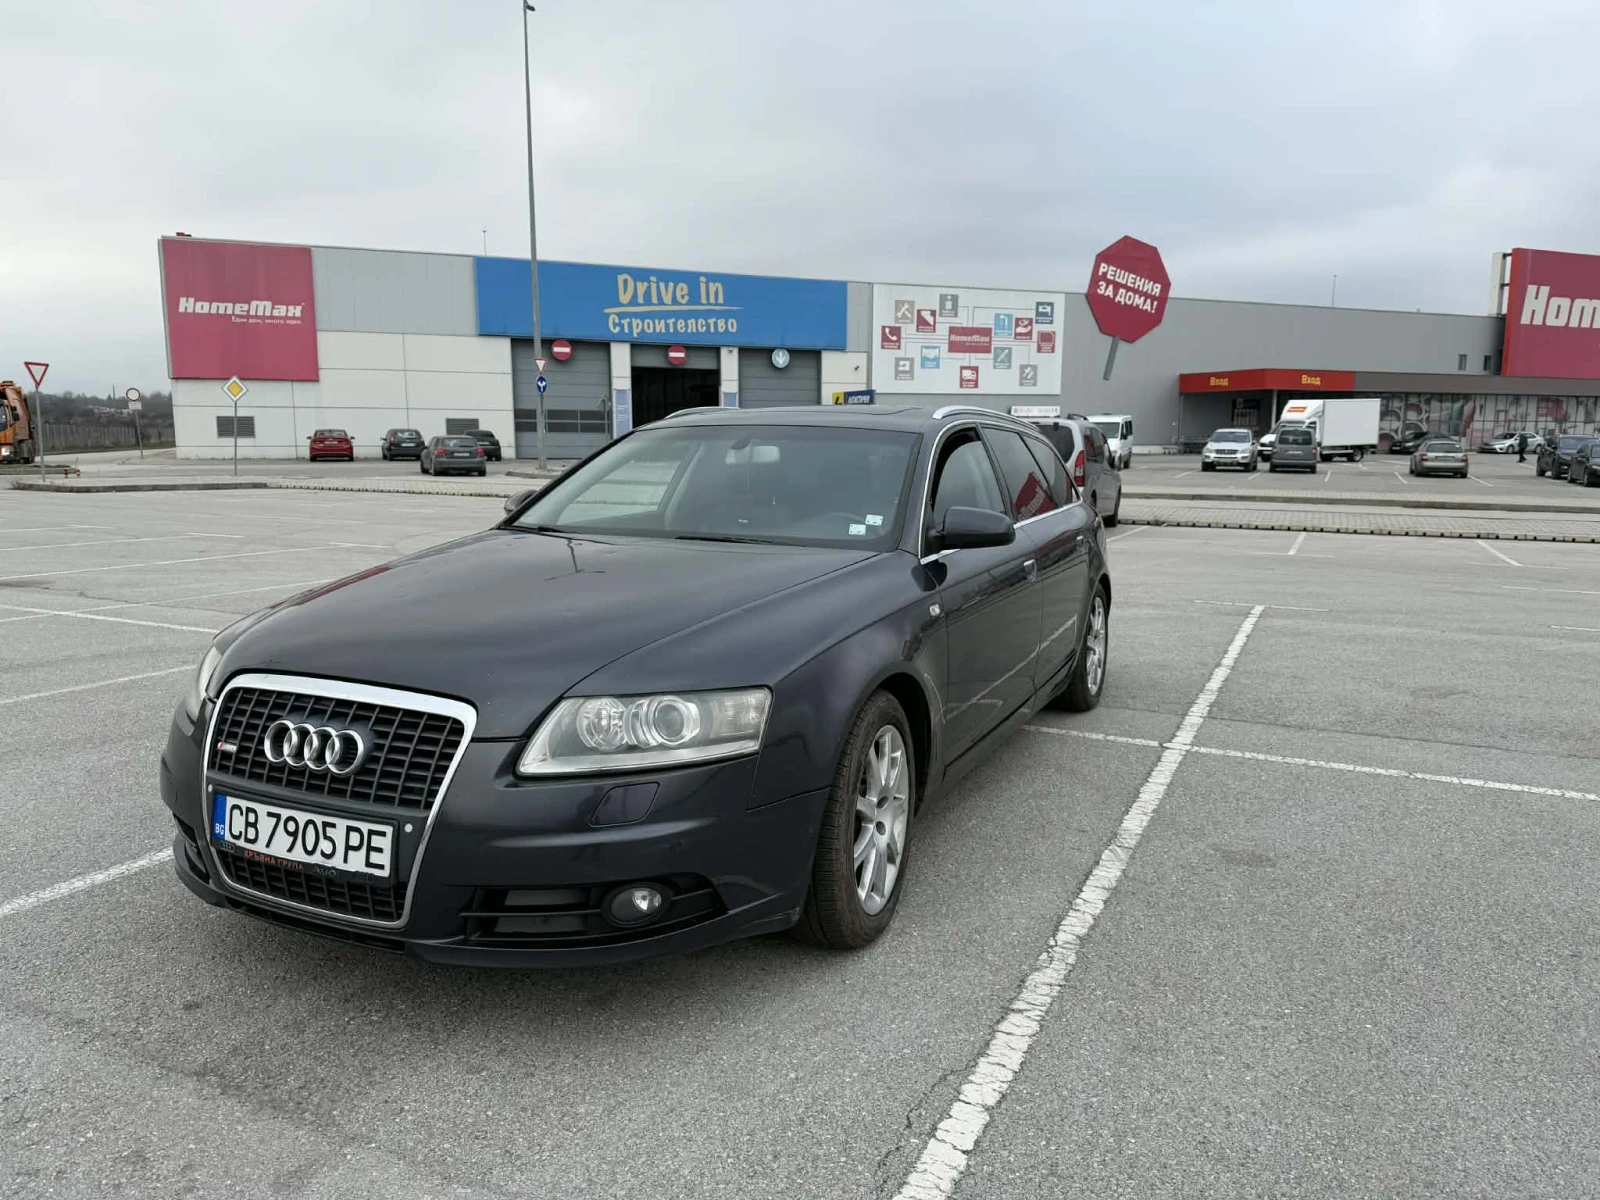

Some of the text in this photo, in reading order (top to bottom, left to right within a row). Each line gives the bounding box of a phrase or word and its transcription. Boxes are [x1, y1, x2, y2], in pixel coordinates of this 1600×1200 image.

[617, 273, 724, 305] Drive in
[1098, 262, 1161, 297] РЕШЕНИЯ
[178, 296, 303, 318] HomeMax
[1097, 281, 1158, 314] ЗА ДОМА!
[608, 314, 737, 338] Строителство
[1209, 376, 1229, 387] Вход
[1301, 374, 1322, 386] Вход
[215, 823, 225, 835] BG
[228, 803, 388, 871] CB 7905 PE
